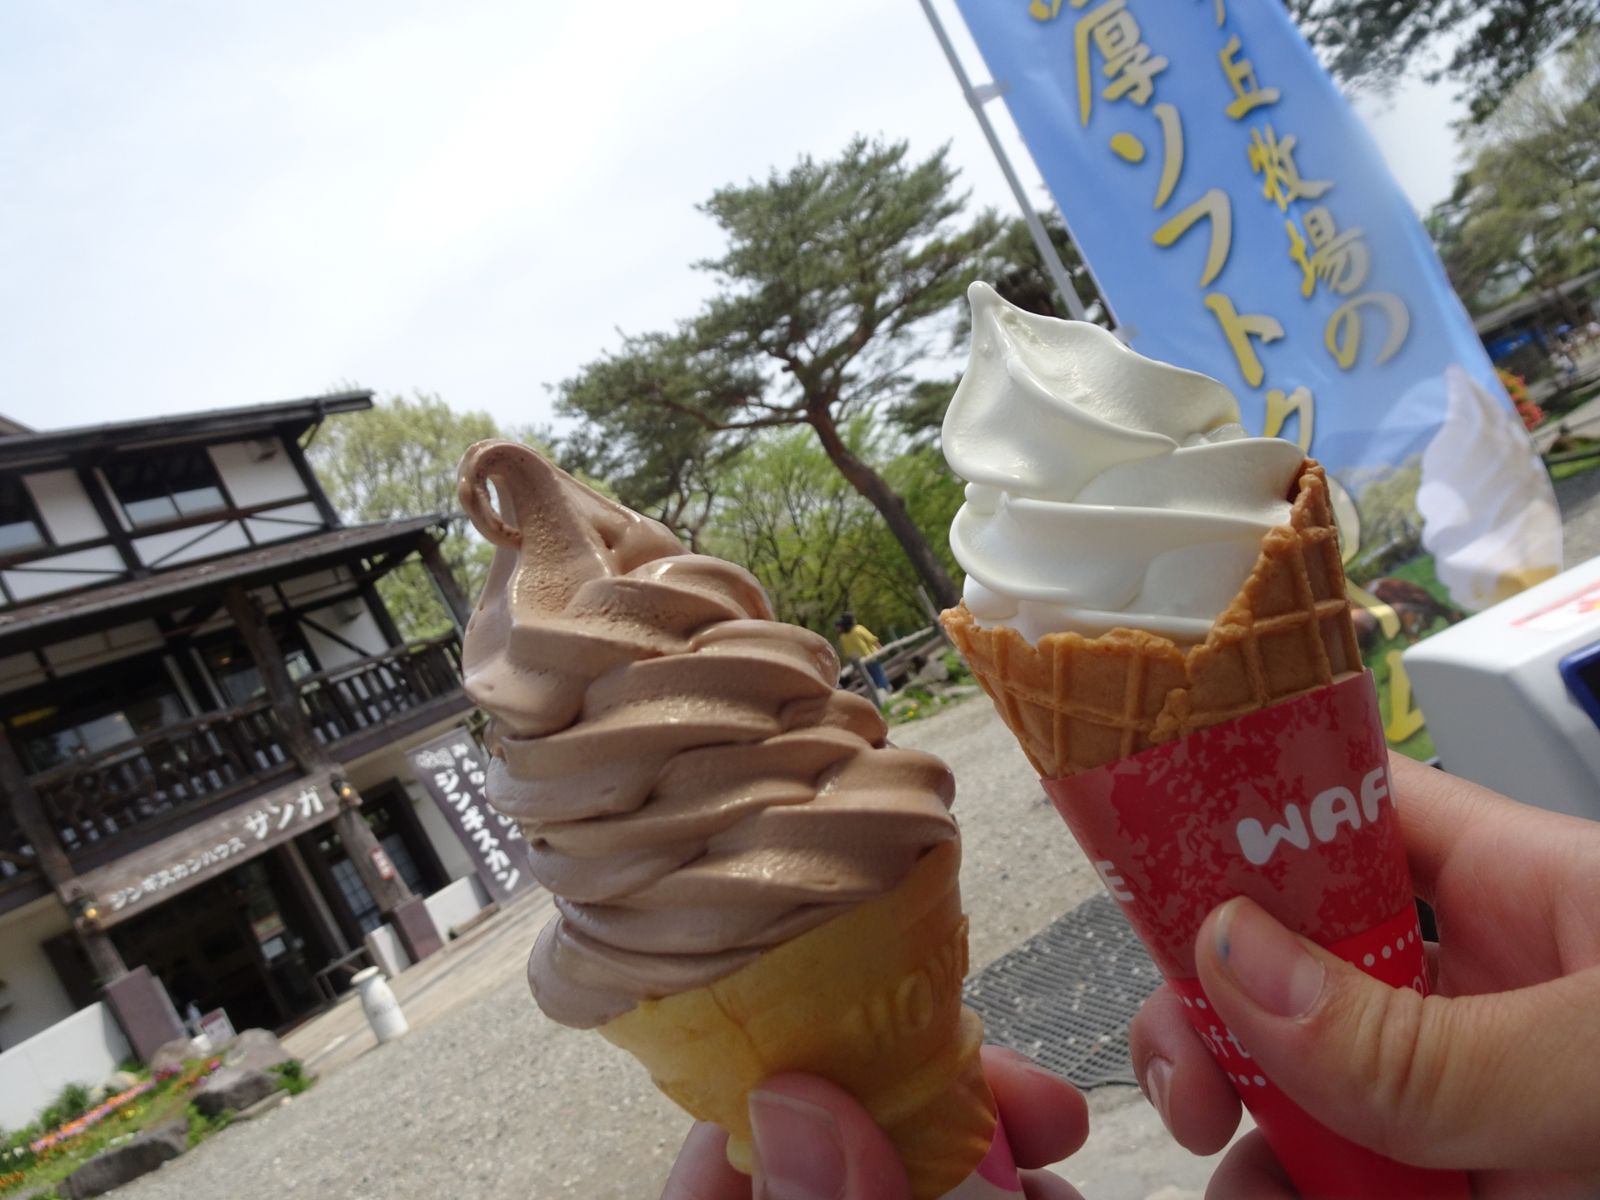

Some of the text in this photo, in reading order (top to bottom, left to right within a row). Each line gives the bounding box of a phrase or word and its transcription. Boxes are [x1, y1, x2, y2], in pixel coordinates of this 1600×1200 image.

[244, 785, 325, 840] サンガ
[433, 768, 521, 891] ジンギスカン
[1236, 766, 1396, 866] WAF
